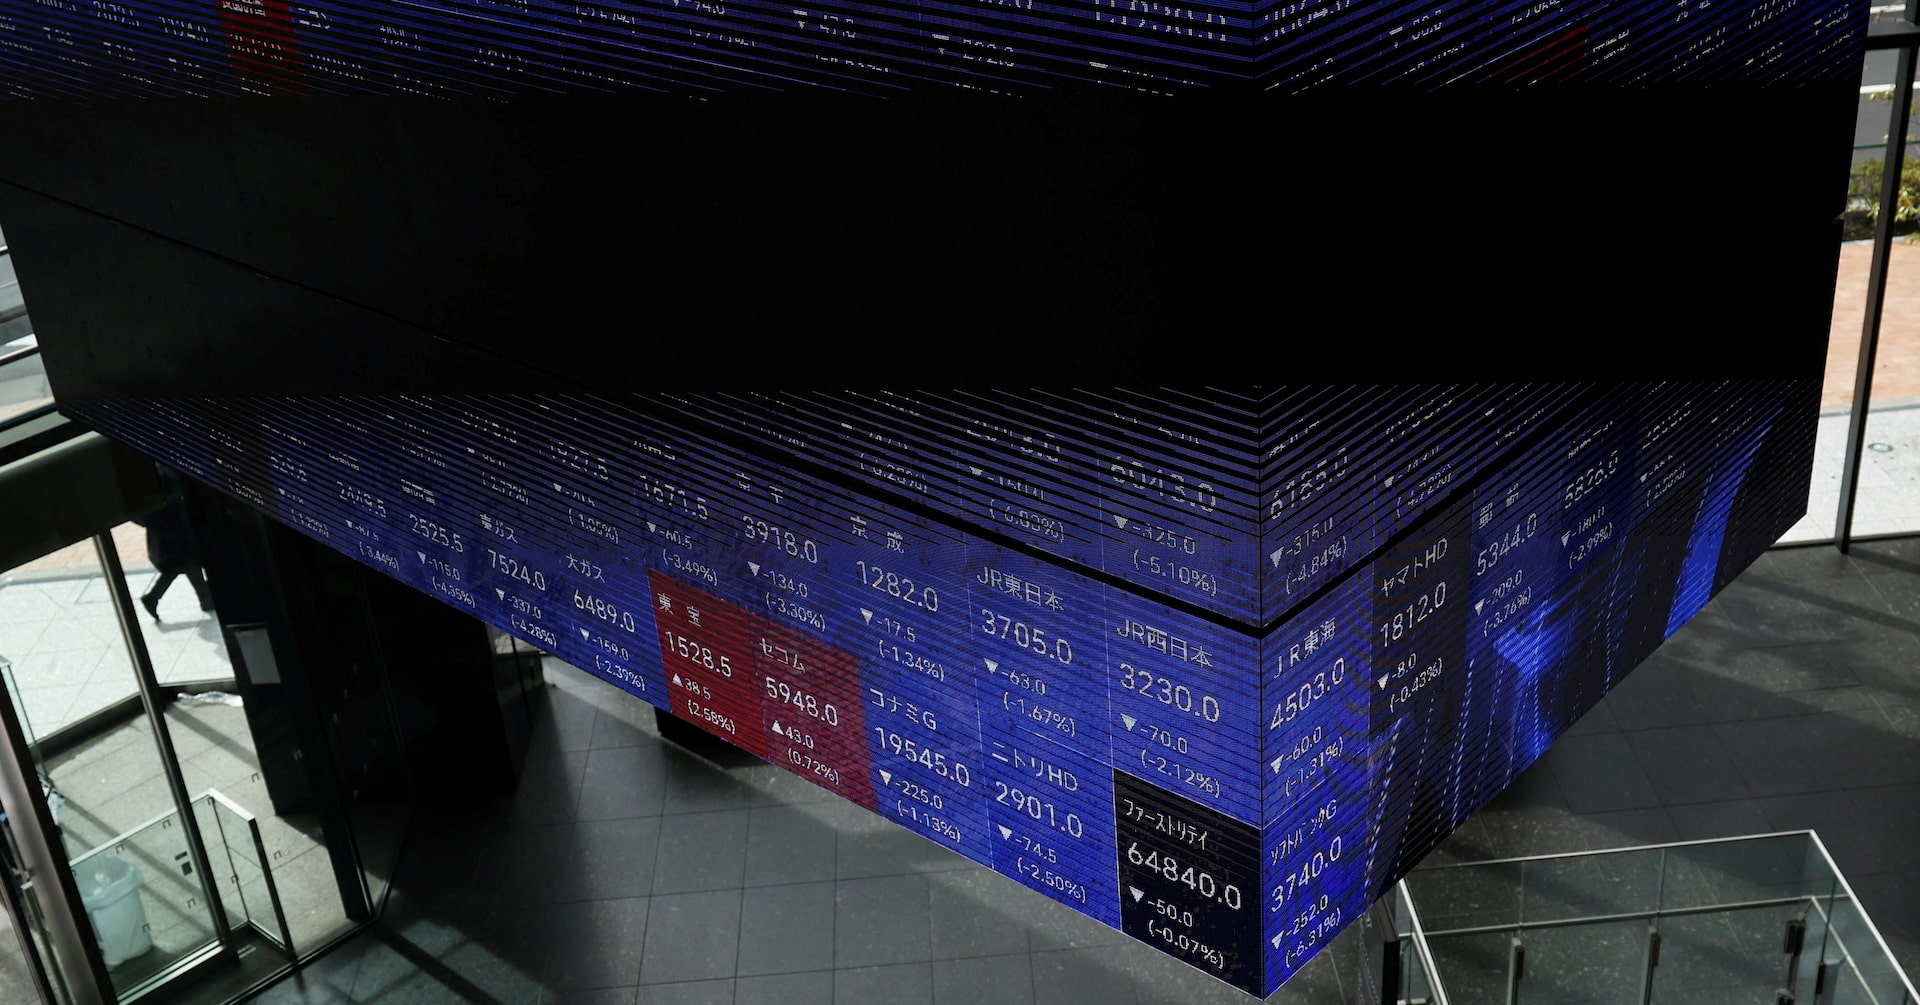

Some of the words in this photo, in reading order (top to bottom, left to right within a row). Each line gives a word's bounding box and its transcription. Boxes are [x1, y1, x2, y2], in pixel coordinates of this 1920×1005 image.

[409, 513, 464, 553] 2525.5
[743, 515, 818, 564] 3918.0
[1476, 512, 1537, 577] 5344.0
[1568, 521, 1613, 570] (-2.99%)
[428, 557, 461, 581] -115.0
[488, 548, 546, 592] 7524.0
[565, 553, 606, 584] 大ガス
[662, 548, 718, 587] (-3.49%)
[763, 571, 808, 599] -134.0
[856, 560, 939, 612] 1282.0
[1133, 548, 1217, 597] (-5.10%)
[1285, 535, 1348, 595] (-4.84%)
[1381, 537, 1448, 598] ヤマトHD
[432, 575, 476, 609] (-4.35%)
[507, 594, 542, 620] -337.0
[976, 566, 1064, 612] JR東日本
[1485, 569, 1523, 606] -209.0
[511, 613, 557, 650] (-4.28%)
[573, 589, 636, 633] 6489.0
[765, 591, 826, 633] (-3.30%)
[876, 617, 916, 643] -17.5
[1380, 581, 1447, 648] 1812.0
[1483, 586, 1532, 638] (-3.76%)
[592, 635, 630, 662] -159.0
[665, 631, 732, 678] 1528.5
[759, 637, 806, 673] セコム
[981, 608, 1073, 665] 3705.0
[1116, 619, 1214, 668] JR西日本
[1273, 617, 1336, 679] JR東海
[595, 654, 646, 692] (-2.39%)
[878, 639, 945, 682] (-1.34%)
[1001, 669, 1046, 695] -63.0
[1391, 652, 1417, 680] -8.0
[685, 677, 712, 700] 38.5
[765, 676, 838, 727] 5948.0
[1119, 663, 1220, 723] 3230.0
[1270, 657, 1345, 731] 4503.0
[1389, 657, 1444, 713] (-0.43%)
[687, 699, 736, 735] (2.58%)
[869, 688, 937, 731] コナミG
[1003, 691, 1076, 737] (-1.67%)
[785, 726, 815, 750] 43.0
[875, 727, 970, 787] 19545.0
[1140, 725, 1188, 754] -70.0
[1285, 726, 1322, 761] -60.0
[787, 747, 840, 785] (0.72%)
[991, 741, 1078, 791] ニトリHD
[1141, 749, 1220, 798] (-2.12%)
[1285, 736, 1344, 797] (-1.31%)
[895, 781, 943, 809] -225.0
[995, 781, 1083, 838] 2901.0
[897, 800, 961, 843] (-1.13%)
[1014, 836, 1058, 864] -74.5
[1017, 857, 1087, 904] (-2.50%)
[1127, 842, 1242, 910] 64840.0
[1271, 835, 1342, 913] 3740.0
[1147, 899, 1193, 927] -50.0
[1285, 894, 1328, 936] -252.0
[1148, 919, 1224, 969] (-0.07%)
[1285, 907, 1342, 969] (-6.31%)
